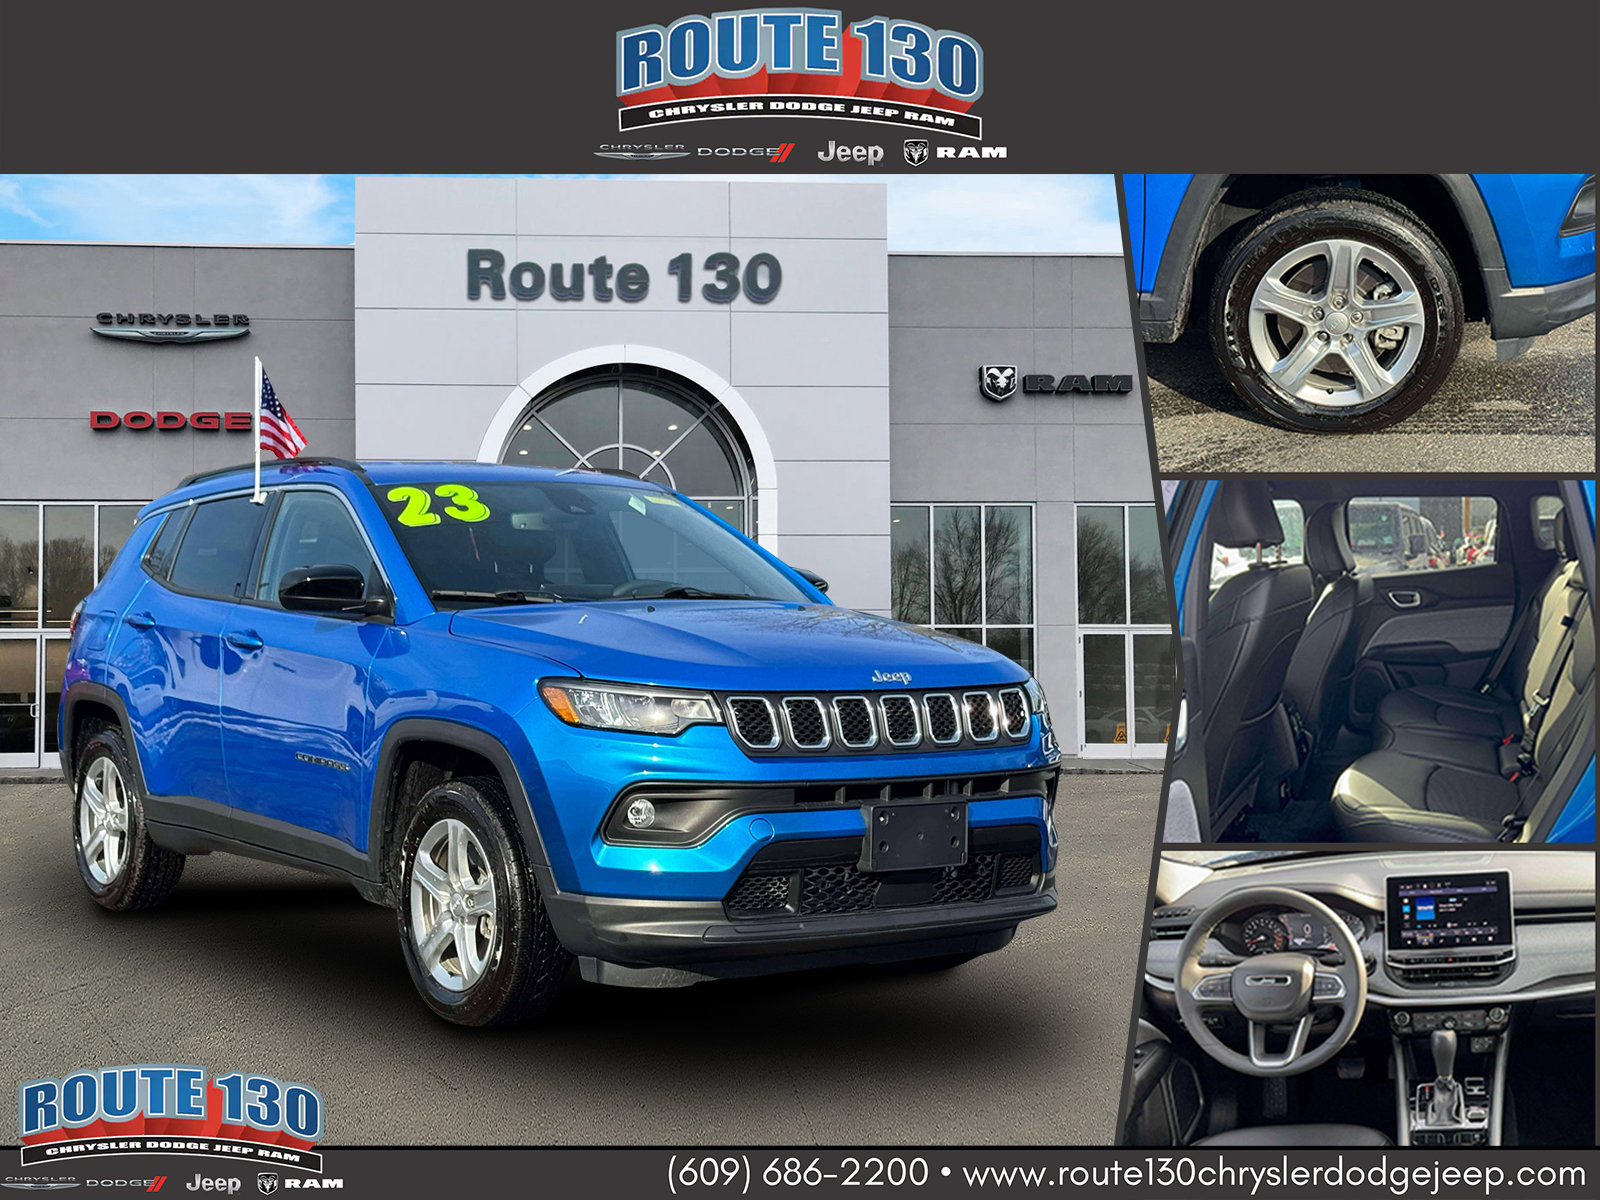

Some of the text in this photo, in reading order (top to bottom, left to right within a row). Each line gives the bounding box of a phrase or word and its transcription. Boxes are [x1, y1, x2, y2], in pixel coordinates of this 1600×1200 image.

[467, 248, 783, 304] Route 130
[96, 312, 250, 326] CHRYSLER
[1023, 374, 1134, 395] RAM
[90, 410, 253, 431] DODGE
[387, 484, 491, 527] 23
[871, 669, 913, 686] Jeep
